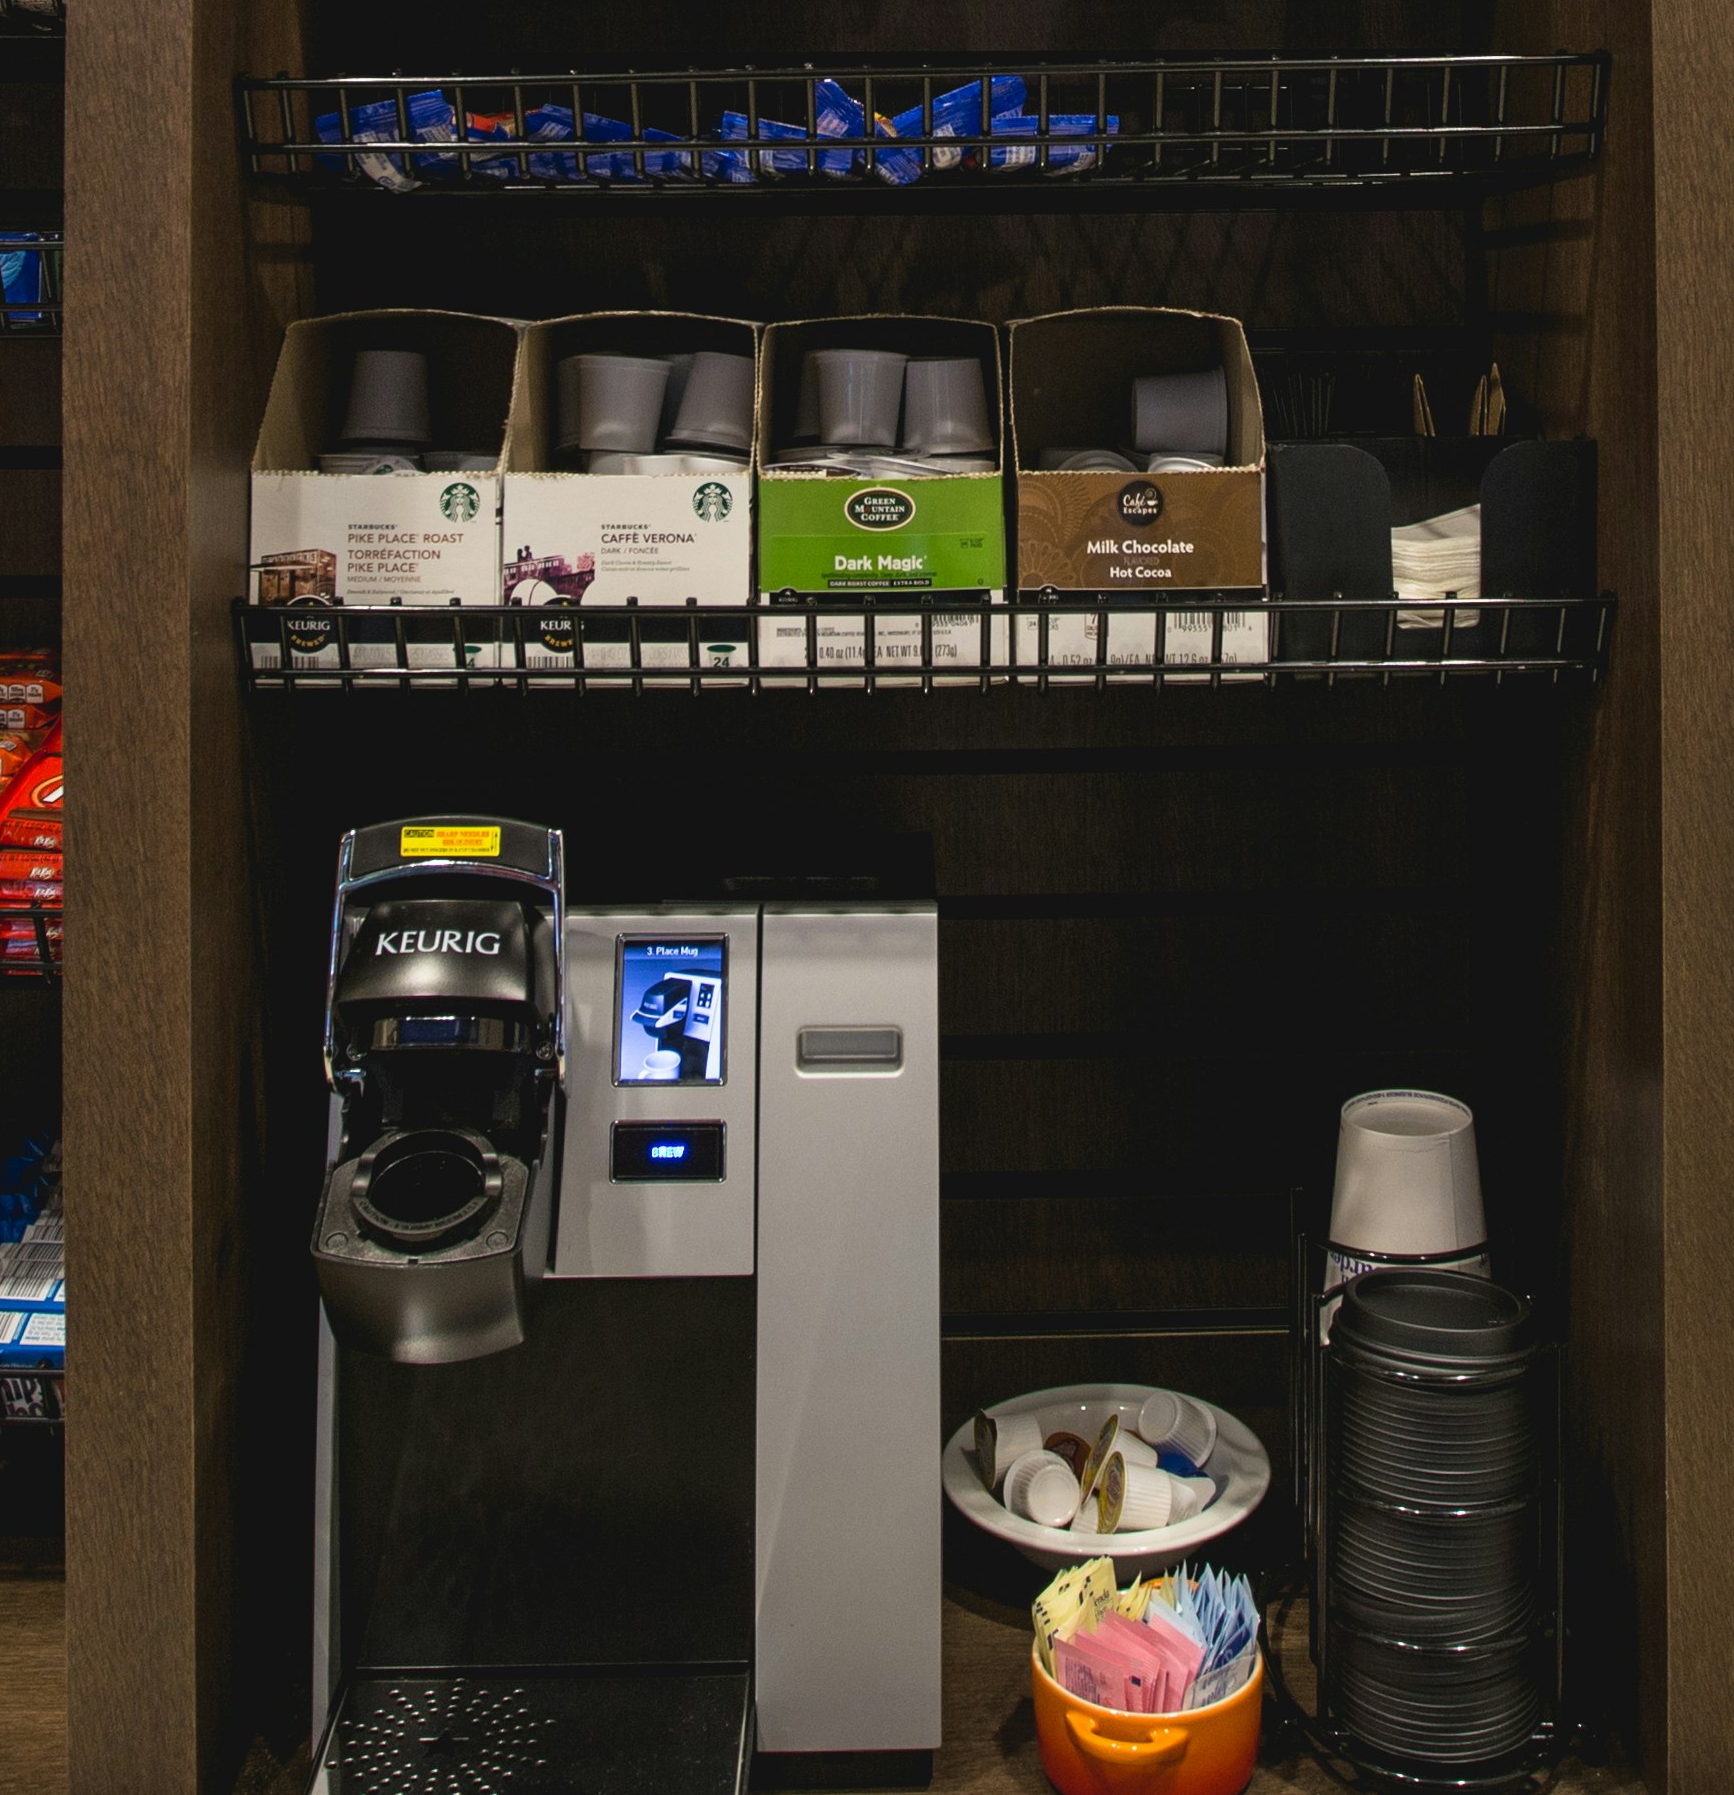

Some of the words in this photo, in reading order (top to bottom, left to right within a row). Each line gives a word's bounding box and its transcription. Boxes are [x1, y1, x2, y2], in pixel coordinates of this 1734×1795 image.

[864, 497, 896, 505] GREEN
[855, 505, 906, 514] MOUNTAIN
[1123, 507, 1157, 515] Escapes
[861, 513, 899, 522] COFFEE
[348, 534, 374, 543] PIKE
[378, 534, 416, 543] PLACE
[424, 534, 464, 543] ROAST
[601, 532, 639, 544] CAFFÈ
[643, 533, 695, 544] VERONA
[1087, 540, 1119, 554] Milk
[1122, 540, 1194, 554] Chocolate
[347, 548, 441, 560] TORRÉFACTION
[347, 563, 374, 573] PIKE
[378, 563, 416, 573] PLACE
[834, 555, 873, 571] Dark
[877, 555, 923, 572] Magic
[1110, 567, 1133, 578] Hot
[1135, 567, 1172, 578] Cocoa
[287, 620, 331, 631] KEURIG
[714, 657, 730, 668] 24
[375, 930, 501, 955] KEURIG
[656, 947, 679, 955] Place
[681, 947, 698, 957] Mug
[652, 1146, 684, 1157] BREW
